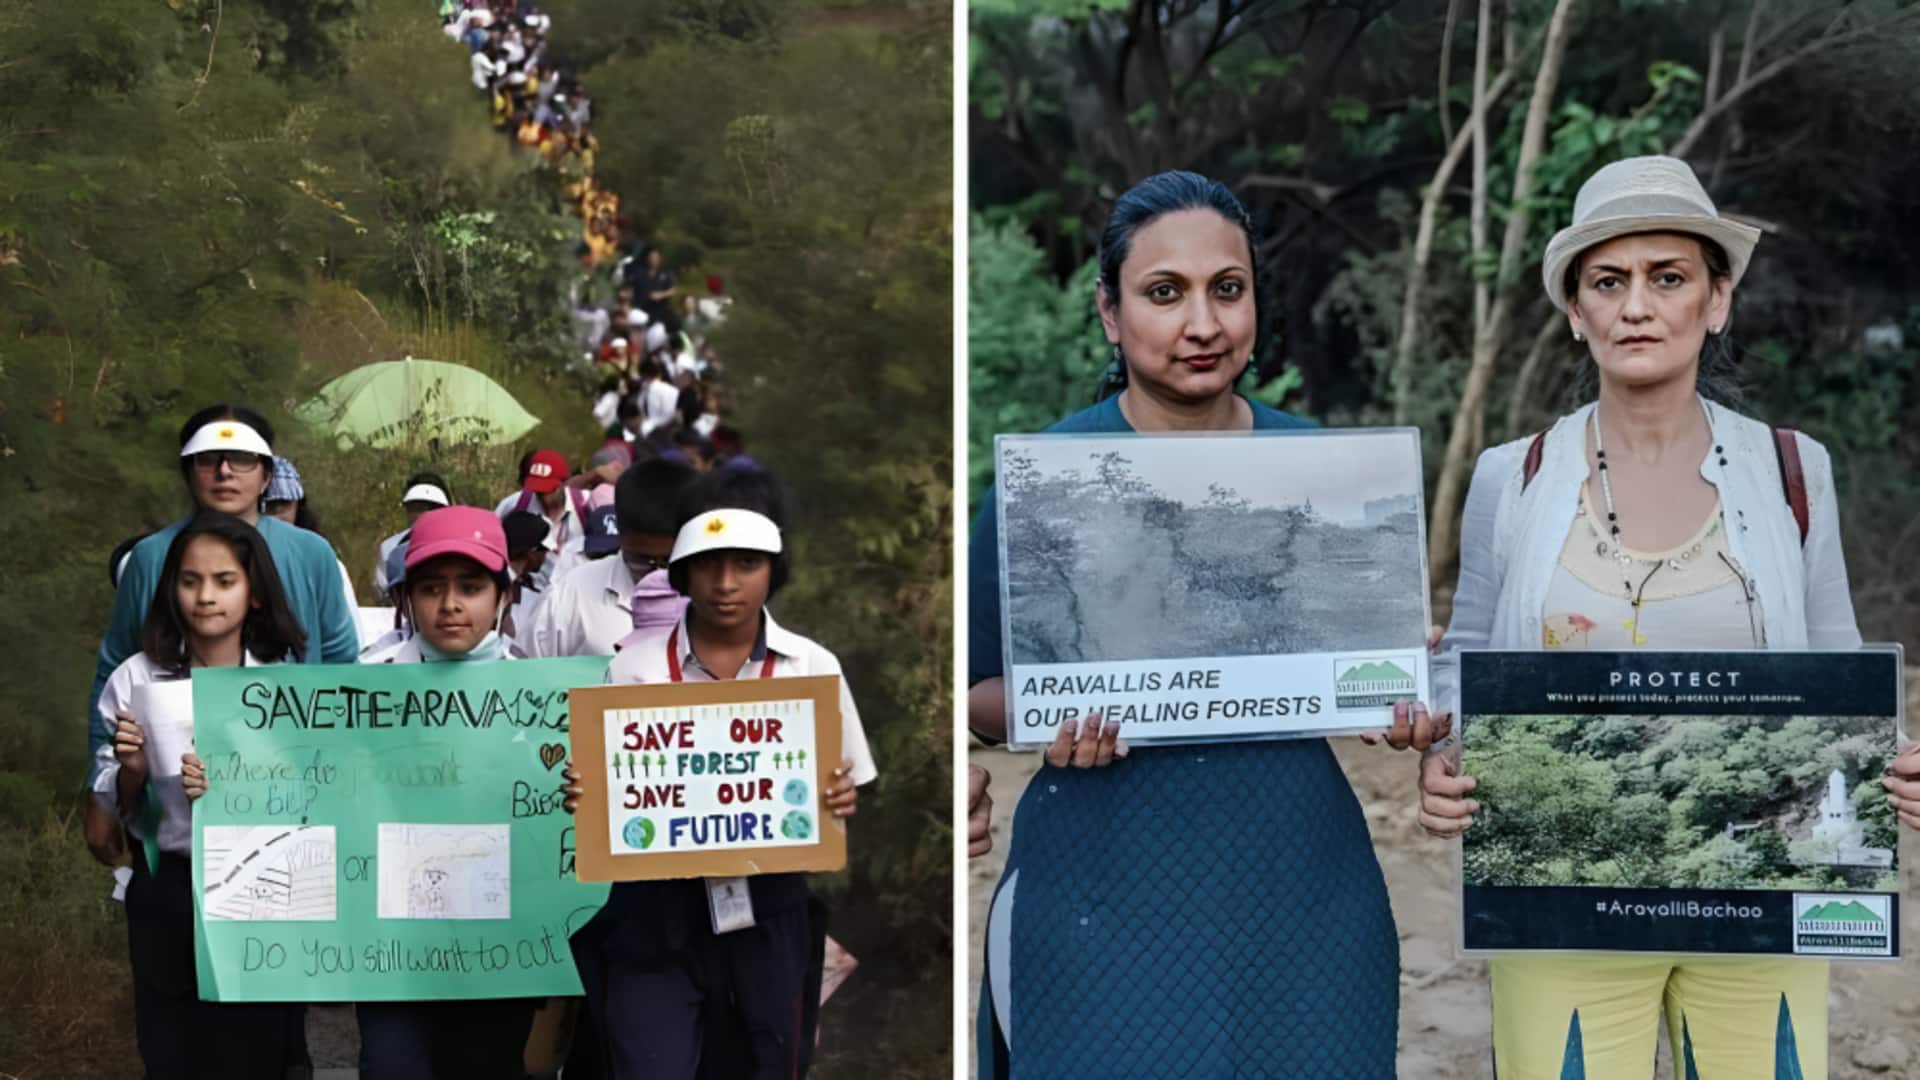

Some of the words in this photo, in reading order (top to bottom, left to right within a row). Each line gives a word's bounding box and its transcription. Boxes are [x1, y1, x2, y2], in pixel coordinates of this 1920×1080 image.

[1020, 671, 1163, 697] ARAVALLIS
[1167, 669, 1222, 691] ARE
[1609, 671, 1741, 688] PROTECT
[241, 682, 337, 729] SAVE
[338, 685, 394, 729] THE
[1205, 695, 1323, 720] FORESTS
[1546, 692, 1574, 703] What
[1576, 693, 1597, 704] you
[1723, 693, 1746, 705] your
[622, 720, 696, 751] SAVE
[729, 718, 784, 744] OUR
[204, 751, 294, 782] Where
[302, 750, 337, 786] do
[676, 750, 761, 777] FOREST
[623, 783, 686, 810] SAVE
[716, 777, 774, 805] OUR
[668, 812, 774, 848] FUTURE
[343, 855, 376, 882] or
[1595, 900, 1764, 919] #AravalliBachao
[243, 937, 287, 973] Do
[363, 938, 401, 974] still
[405, 939, 474, 974] want
[475, 938, 510, 971] to
[516, 925, 565, 970] cut
